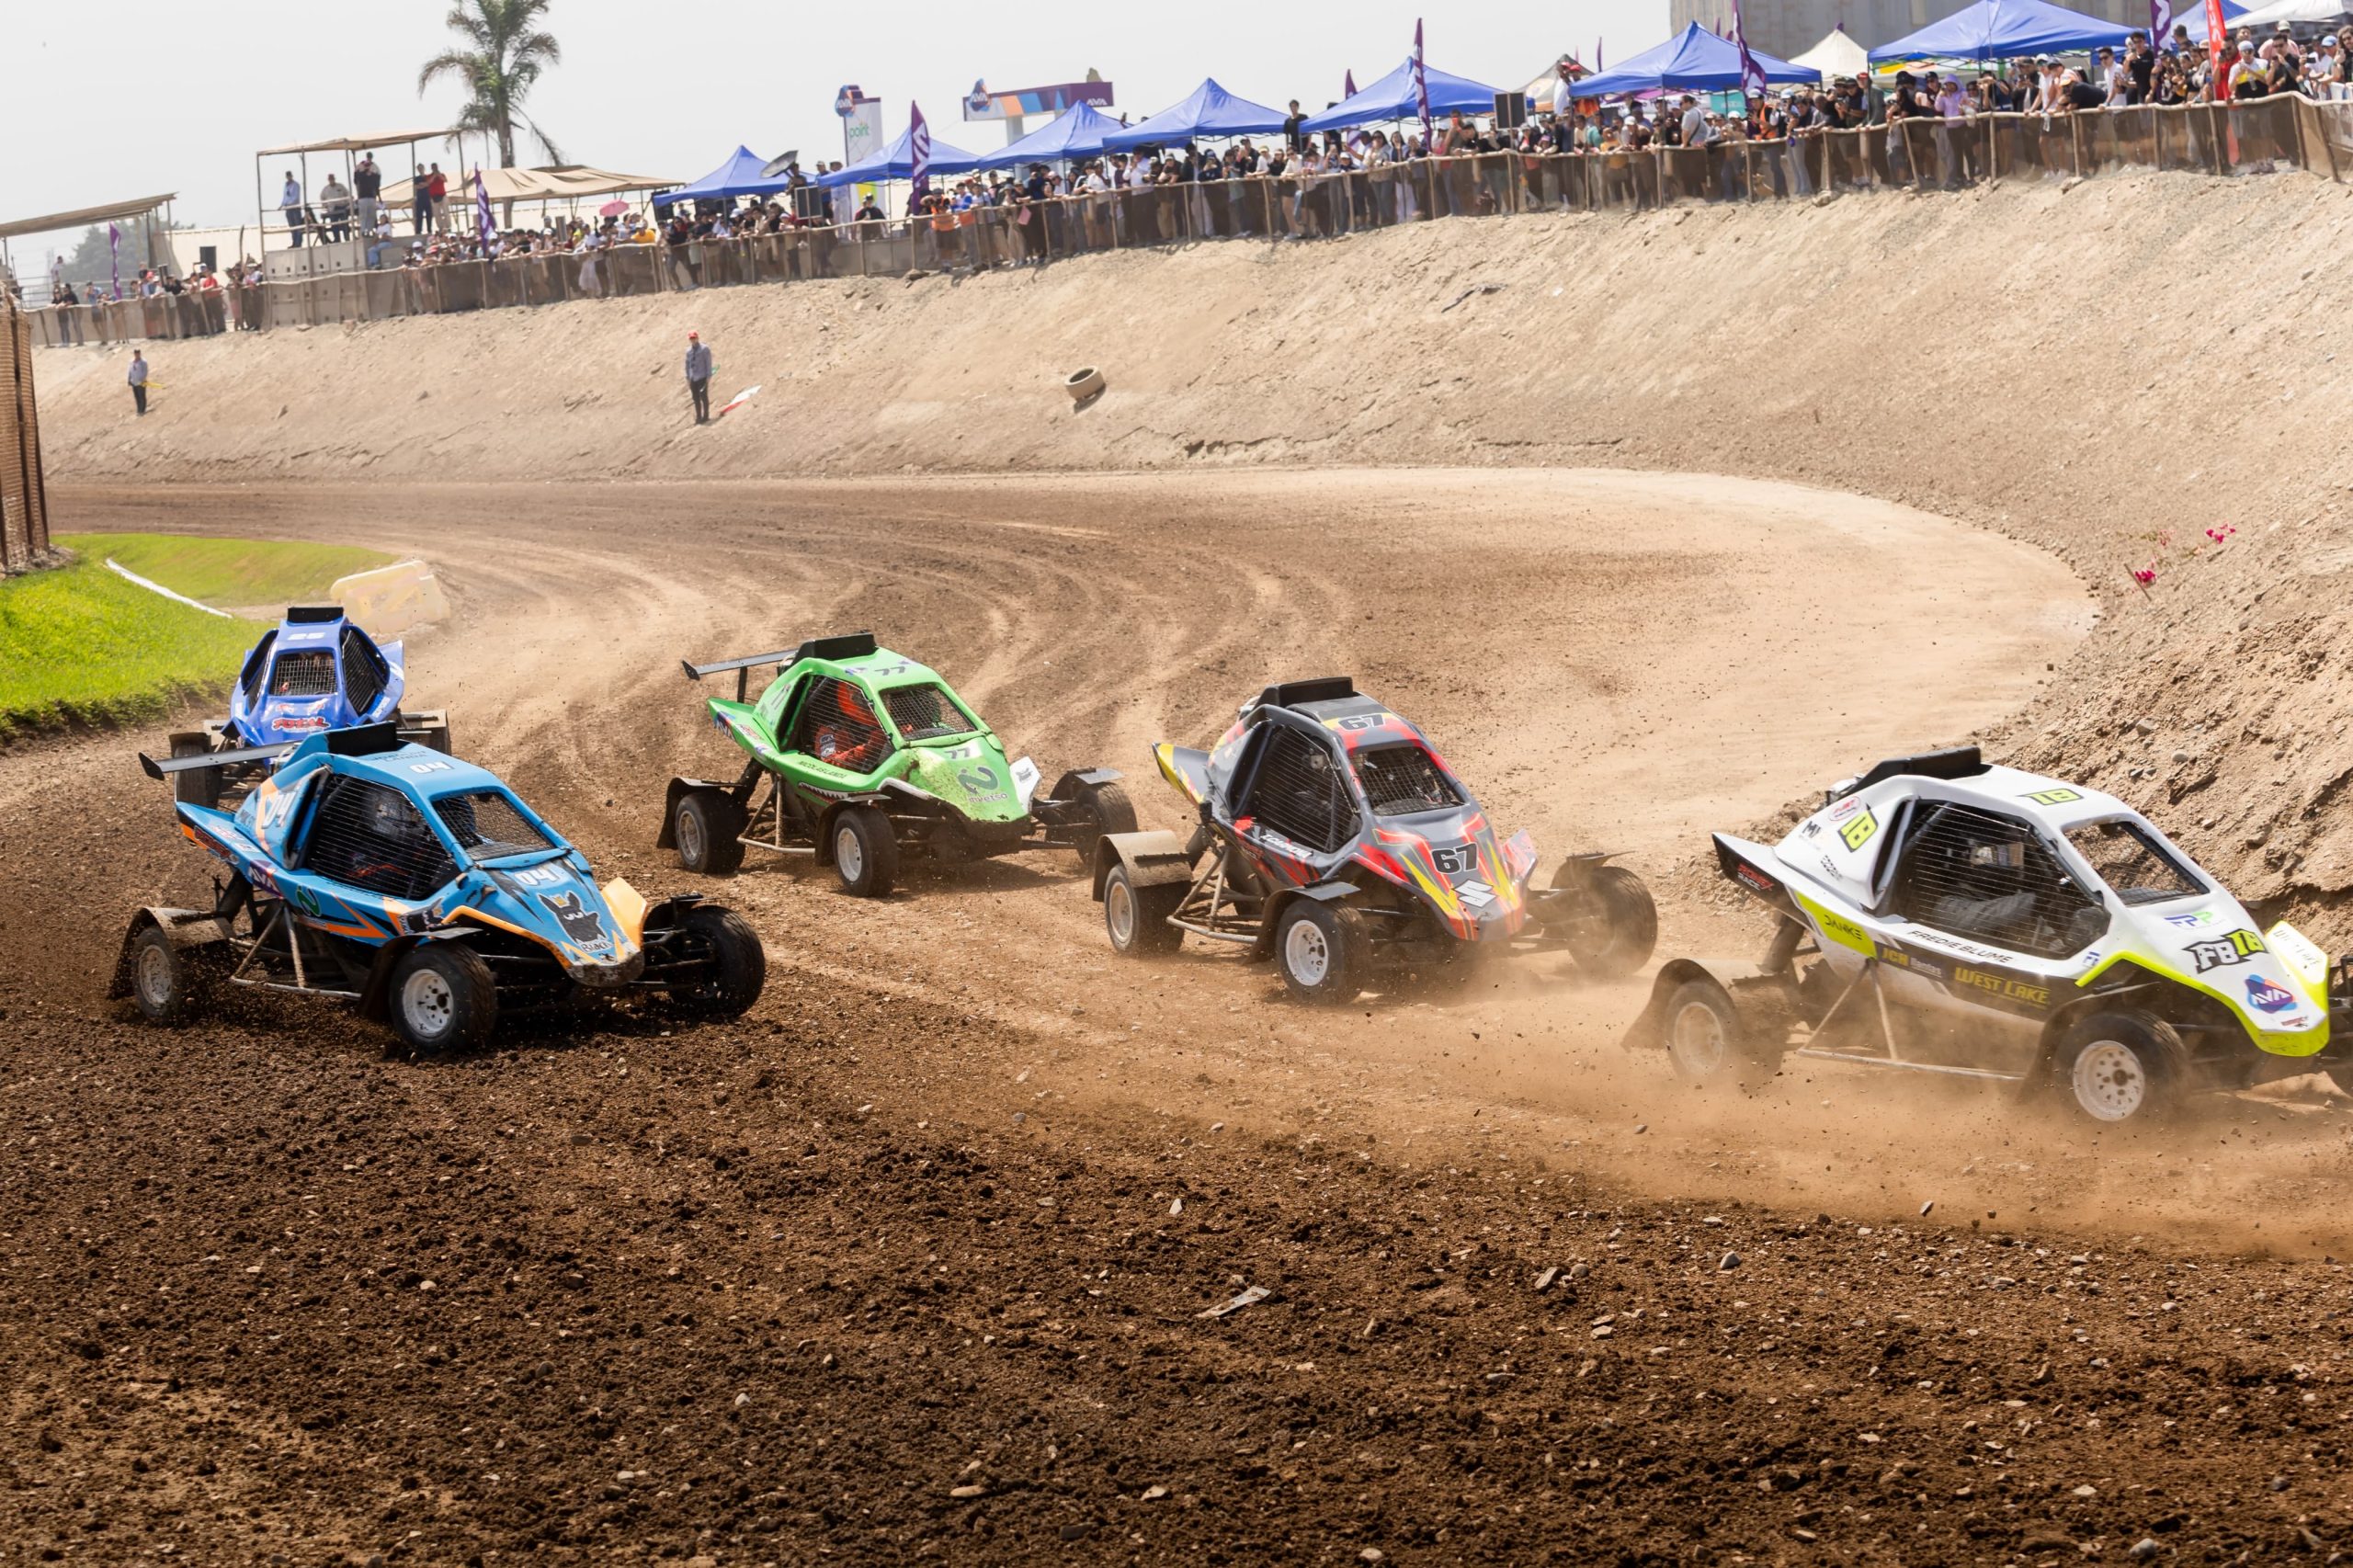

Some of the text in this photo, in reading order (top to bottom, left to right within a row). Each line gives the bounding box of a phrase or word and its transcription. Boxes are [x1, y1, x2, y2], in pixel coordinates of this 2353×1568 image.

[969, 93, 988, 103] AVA
[1086, 97, 1108, 106] AVA
[874, 665, 905, 676] 77
[1337, 713, 1385, 731] 67
[944, 746, 971, 759] 77
[409, 761, 455, 774] 04
[2018, 788, 2084, 806] 18
[262, 791, 297, 829] 04
[1838, 807, 1878, 852] 18
[1431, 842, 1479, 874] 67
[514, 867, 562, 886] 04
[1908, 930, 2014, 964] FREDIE BLUME
[1955, 967, 2006, 992] WEST
[2004, 980, 2052, 1004] LAKE
[2252, 989, 2290, 1005] AVA
